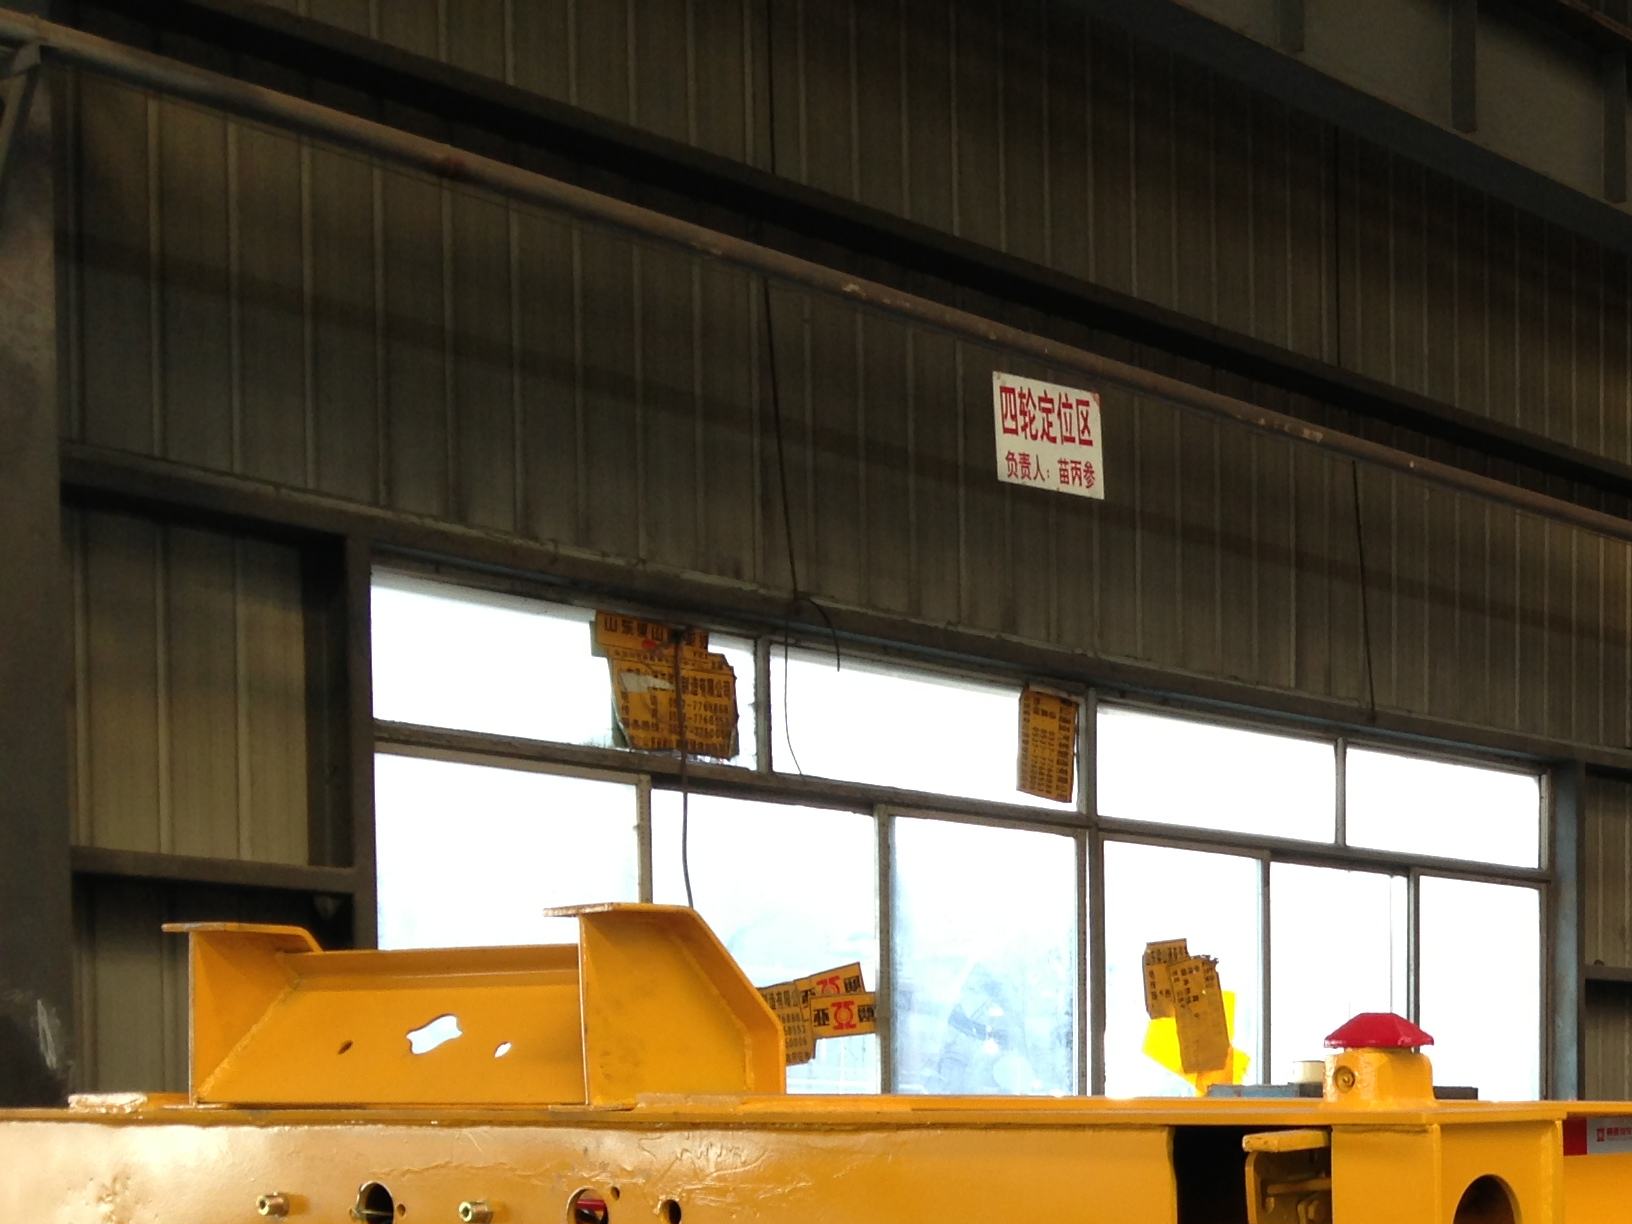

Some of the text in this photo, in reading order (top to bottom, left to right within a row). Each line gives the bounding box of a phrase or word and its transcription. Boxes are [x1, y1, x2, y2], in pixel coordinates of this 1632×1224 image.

[999, 384, 1094, 447] 四轮定位区
